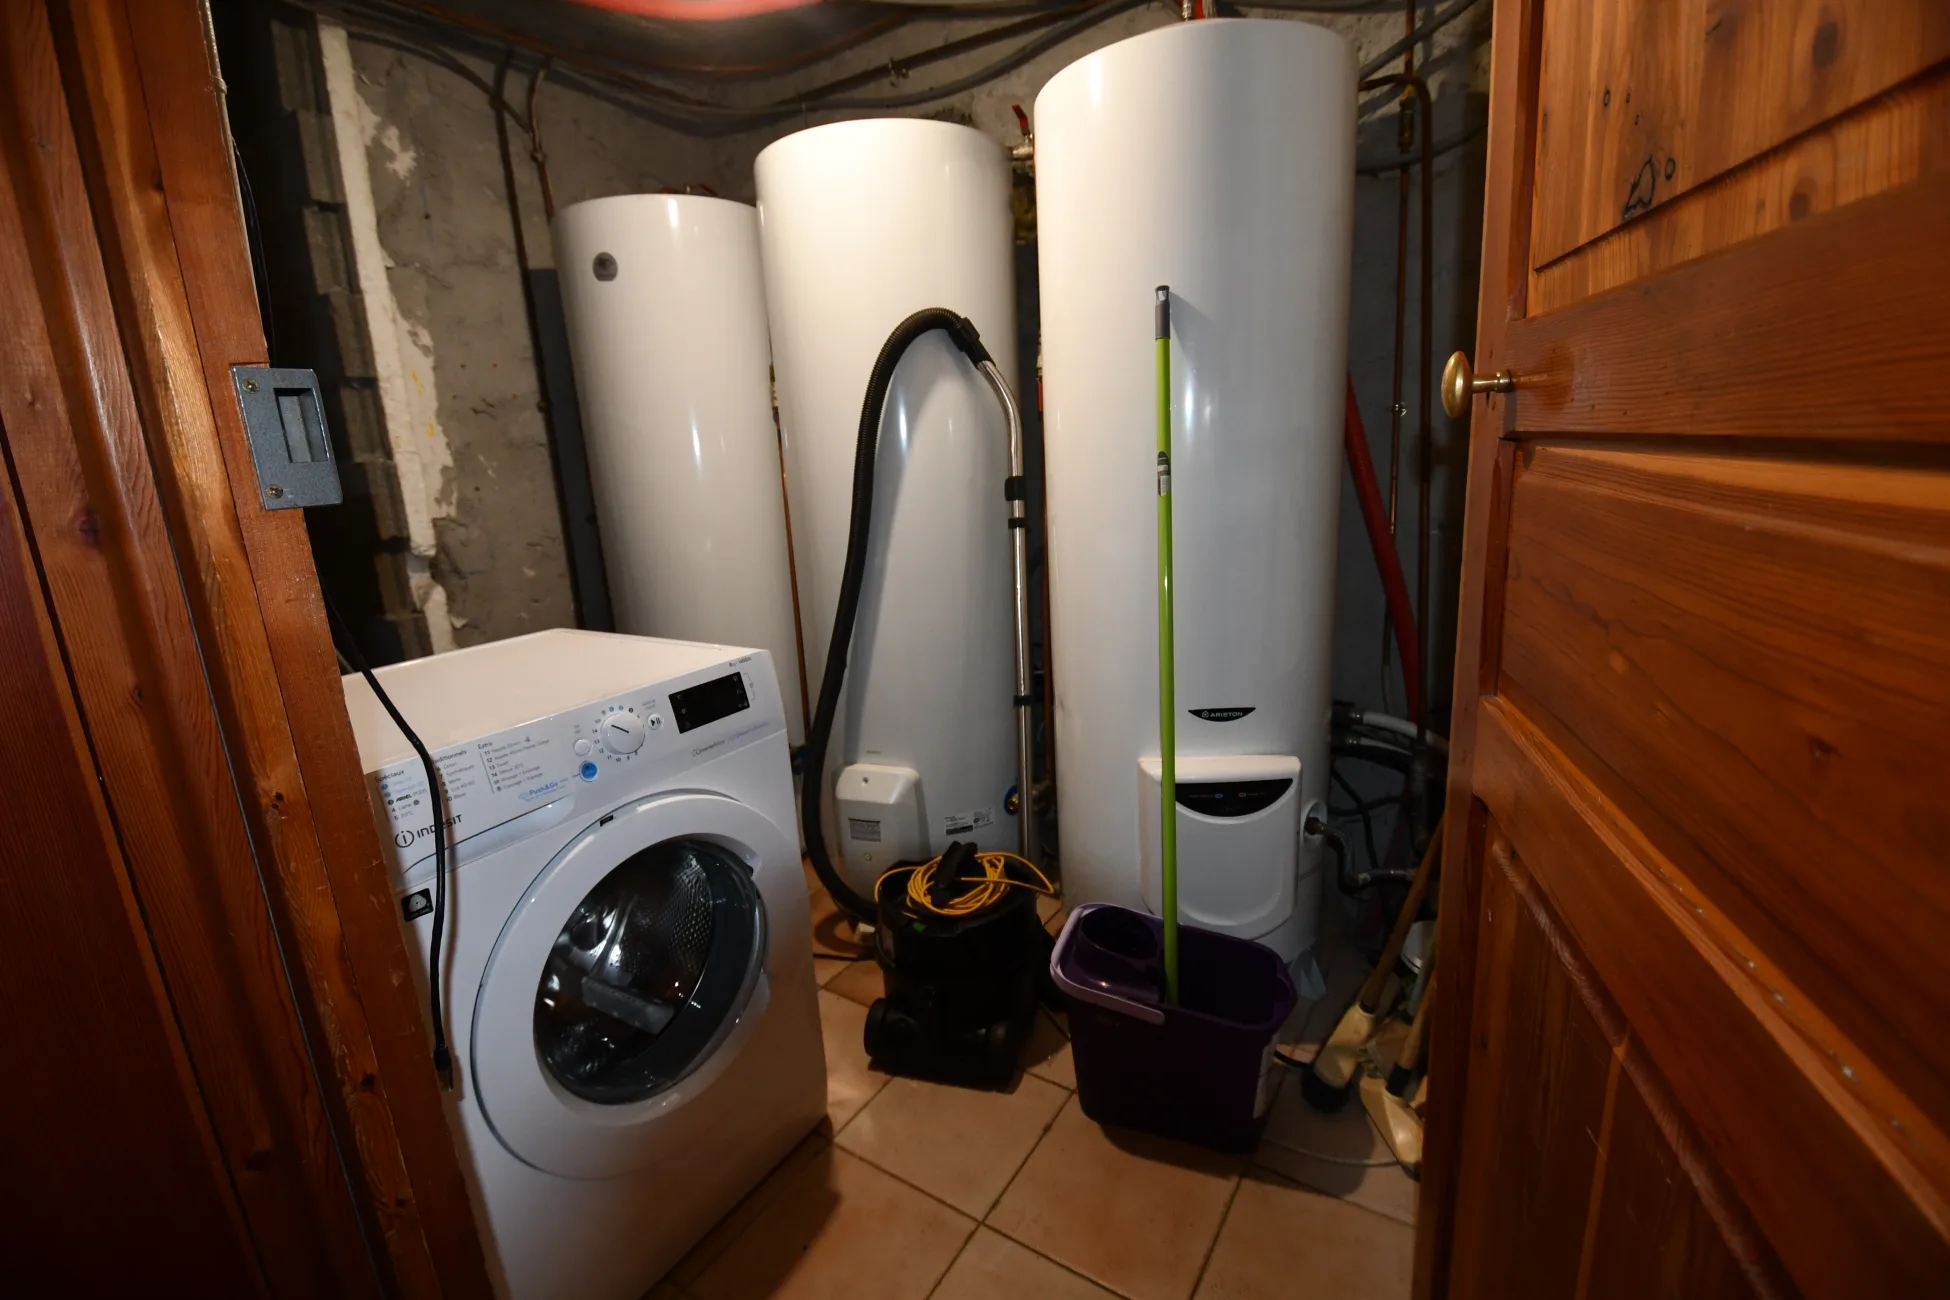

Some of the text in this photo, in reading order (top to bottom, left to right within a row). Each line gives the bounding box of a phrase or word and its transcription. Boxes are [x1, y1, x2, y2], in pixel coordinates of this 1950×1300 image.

[478, 742, 493, 750] Extra
[530, 781, 559, 796] Push&Go
[416, 814, 462, 838] INDSIT
